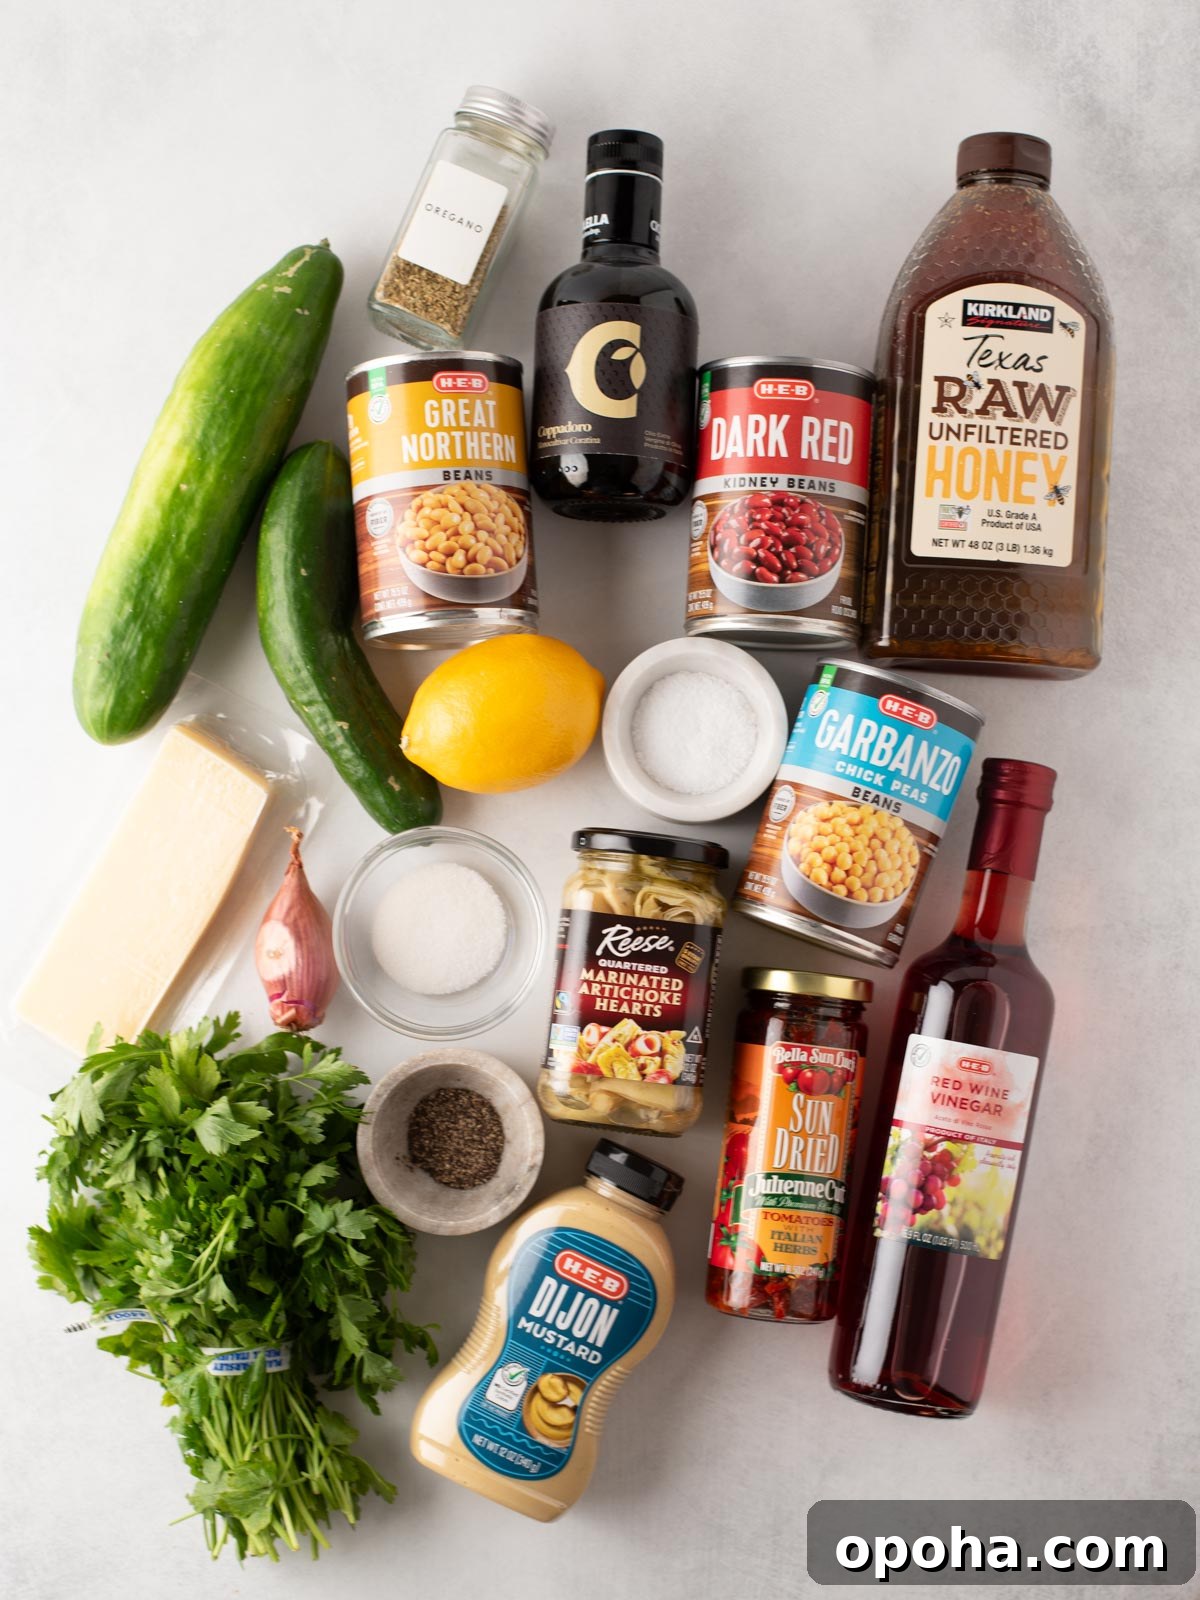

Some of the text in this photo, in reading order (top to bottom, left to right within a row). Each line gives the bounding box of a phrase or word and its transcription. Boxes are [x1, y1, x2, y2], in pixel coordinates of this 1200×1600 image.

[424, 203, 484, 234] OREGANO
[967, 302, 1051, 322] KIRKLAND
[963, 334, 1048, 373] Texas
[931, 375, 1077, 426] RAW
[424, 399, 496, 428] GREAT
[401, 431, 517, 463] NORTHERN
[710, 414, 854, 465] DARK RED
[928, 422, 1069, 450] UNFILTERED
[443, 470, 493, 481] BEANS
[723, 477, 836, 493] KIDNEY BEANS
[924, 445, 1068, 507] HONEY
[981, 519, 1042, 531] Product of USA
[987, 509, 1037, 521] U.S. Grade A
[932, 538, 1053, 557] NET WT 48 OZ (3 LB) 1.36 kg
[815, 709, 962, 796] GARBANZO
[835, 761, 928, 804] CHICK PEAS
[851, 786, 902, 813] BEANS
[598, 958, 669, 974] QUARTERED
[580, 968, 684, 991] MARINATED
[578, 982, 682, 1006] ARTICHOKE
[594, 998, 662, 1018] HEARTS
[773, 1047, 808, 1064] Bella
[809, 1048, 834, 1064] Sun
[930, 1076, 1010, 1100] RED WINE
[789, 1093, 834, 1135] SUN
[930, 1092, 1003, 1117] VINEGAR
[925, 1126, 963, 1139] PRODUCT
[964, 1133, 976, 1141] OF
[772, 1127, 839, 1174] DRIED
[749, 1174, 824, 1198] Julienne
[762, 1211, 834, 1227] TOMATOES
[770, 1230, 824, 1243] ITALIAN
[773, 1242, 818, 1256] HERBS
[563, 1257, 620, 1293] H-E-B
[528, 1275, 620, 1348] DIJON
[517, 1316, 602, 1365] MUSTARD
